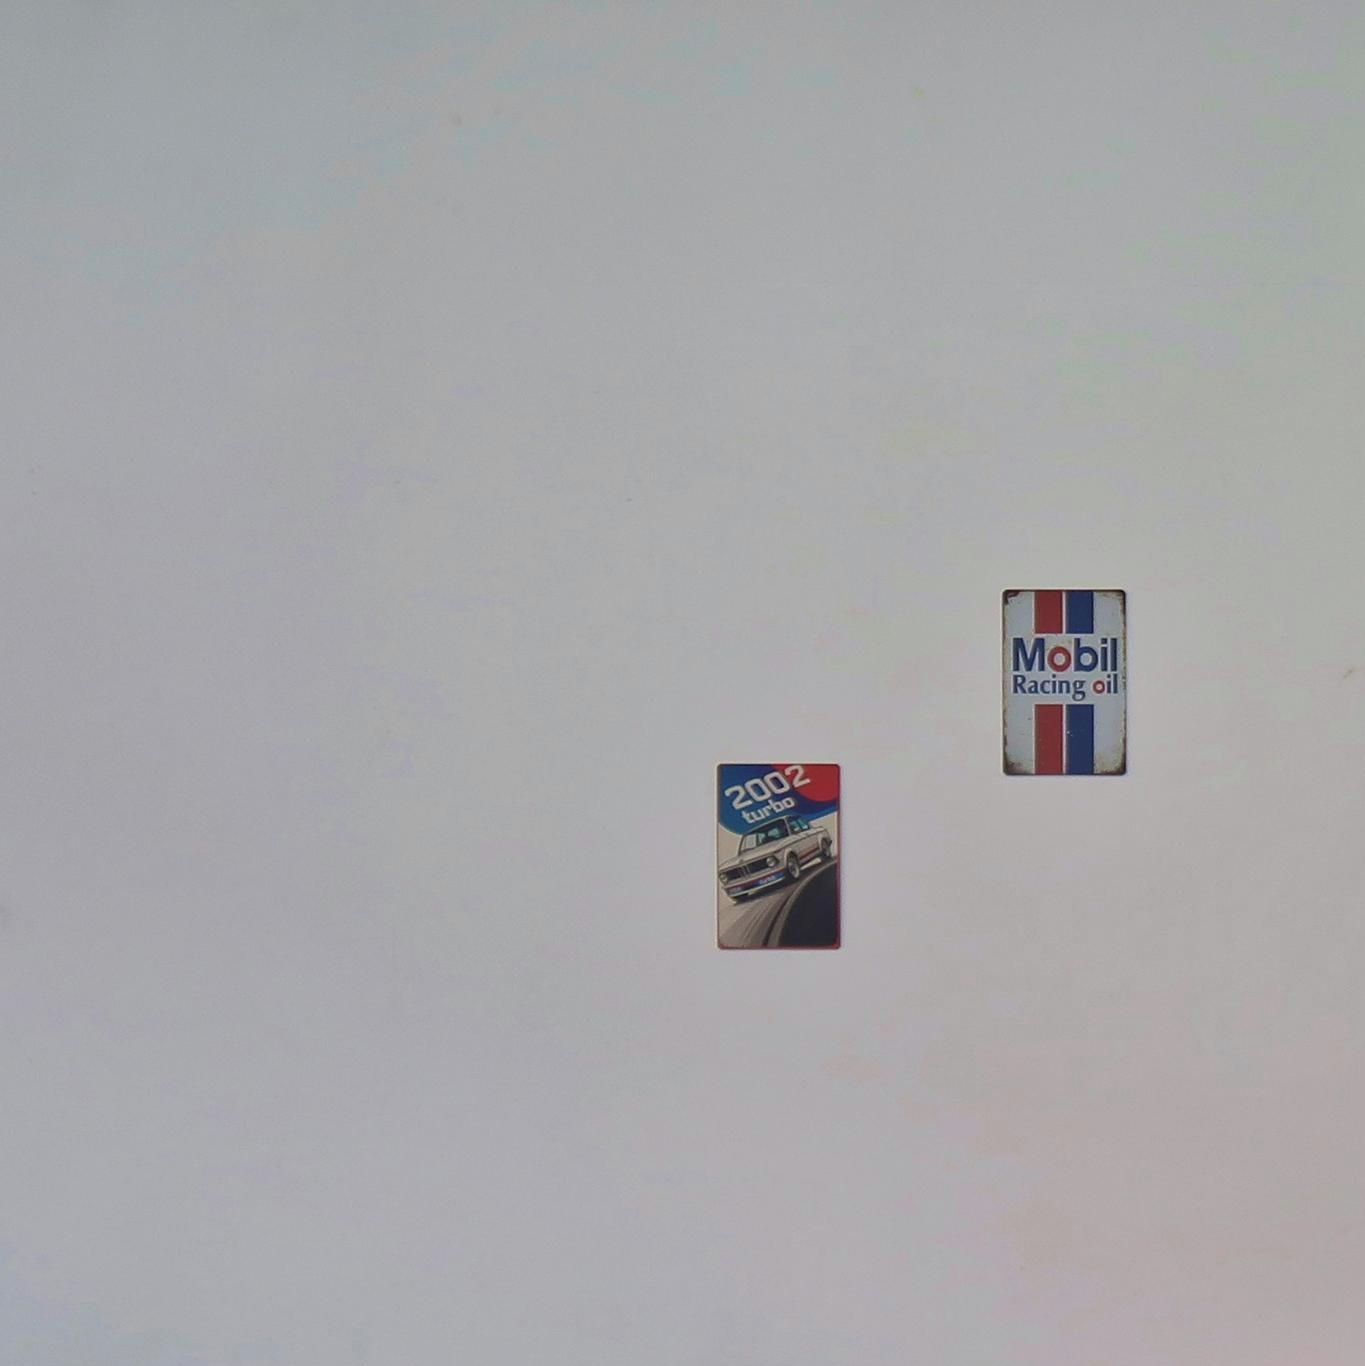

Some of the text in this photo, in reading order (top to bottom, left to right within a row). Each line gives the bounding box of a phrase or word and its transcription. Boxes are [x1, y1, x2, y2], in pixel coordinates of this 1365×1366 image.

[1012, 637, 1118, 672] Mobil
[1012, 673, 1118, 702] Racing oil
[724, 764, 811, 811] 2002
[741, 796, 796, 824] turbo
